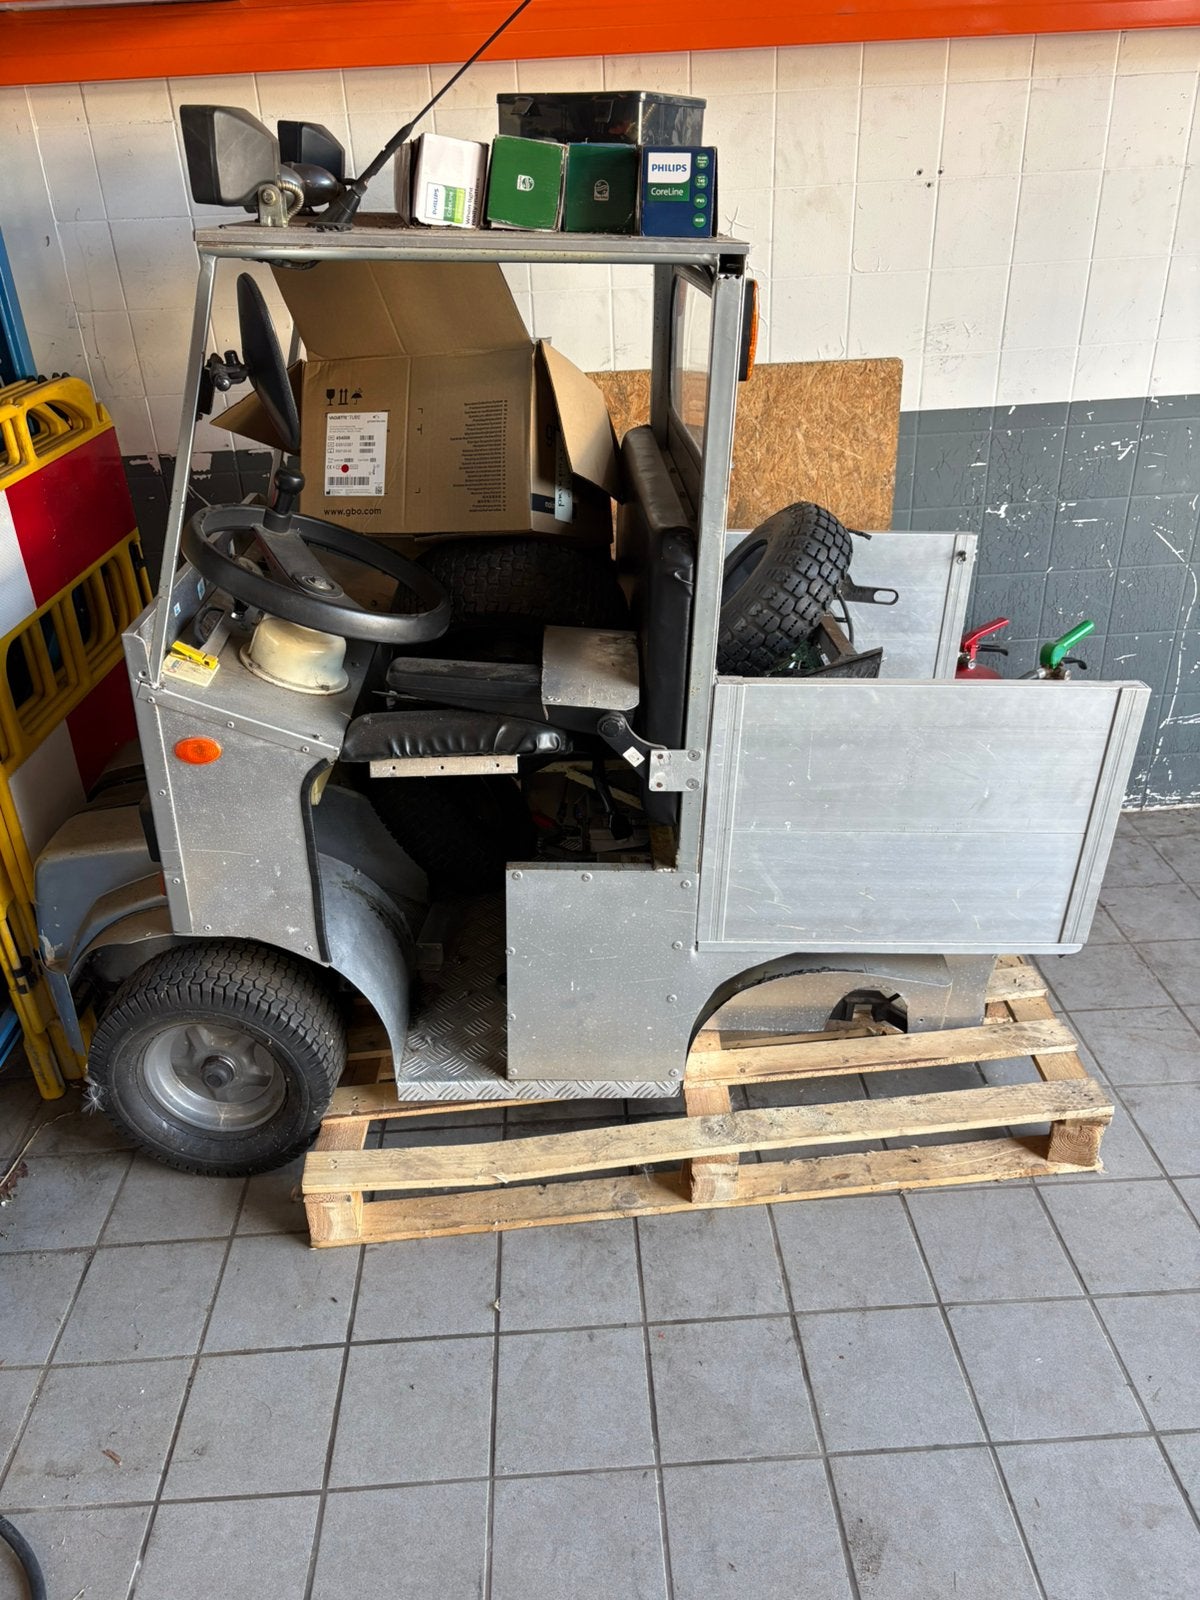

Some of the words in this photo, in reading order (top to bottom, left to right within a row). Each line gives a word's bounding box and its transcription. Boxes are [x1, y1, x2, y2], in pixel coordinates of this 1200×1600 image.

[651, 163, 687, 172] PHILIPS
[651, 187, 684, 196] CoreLine
[432, 188, 440, 215] PHILIPS
[323, 507, 382, 517] www.gbo.com
